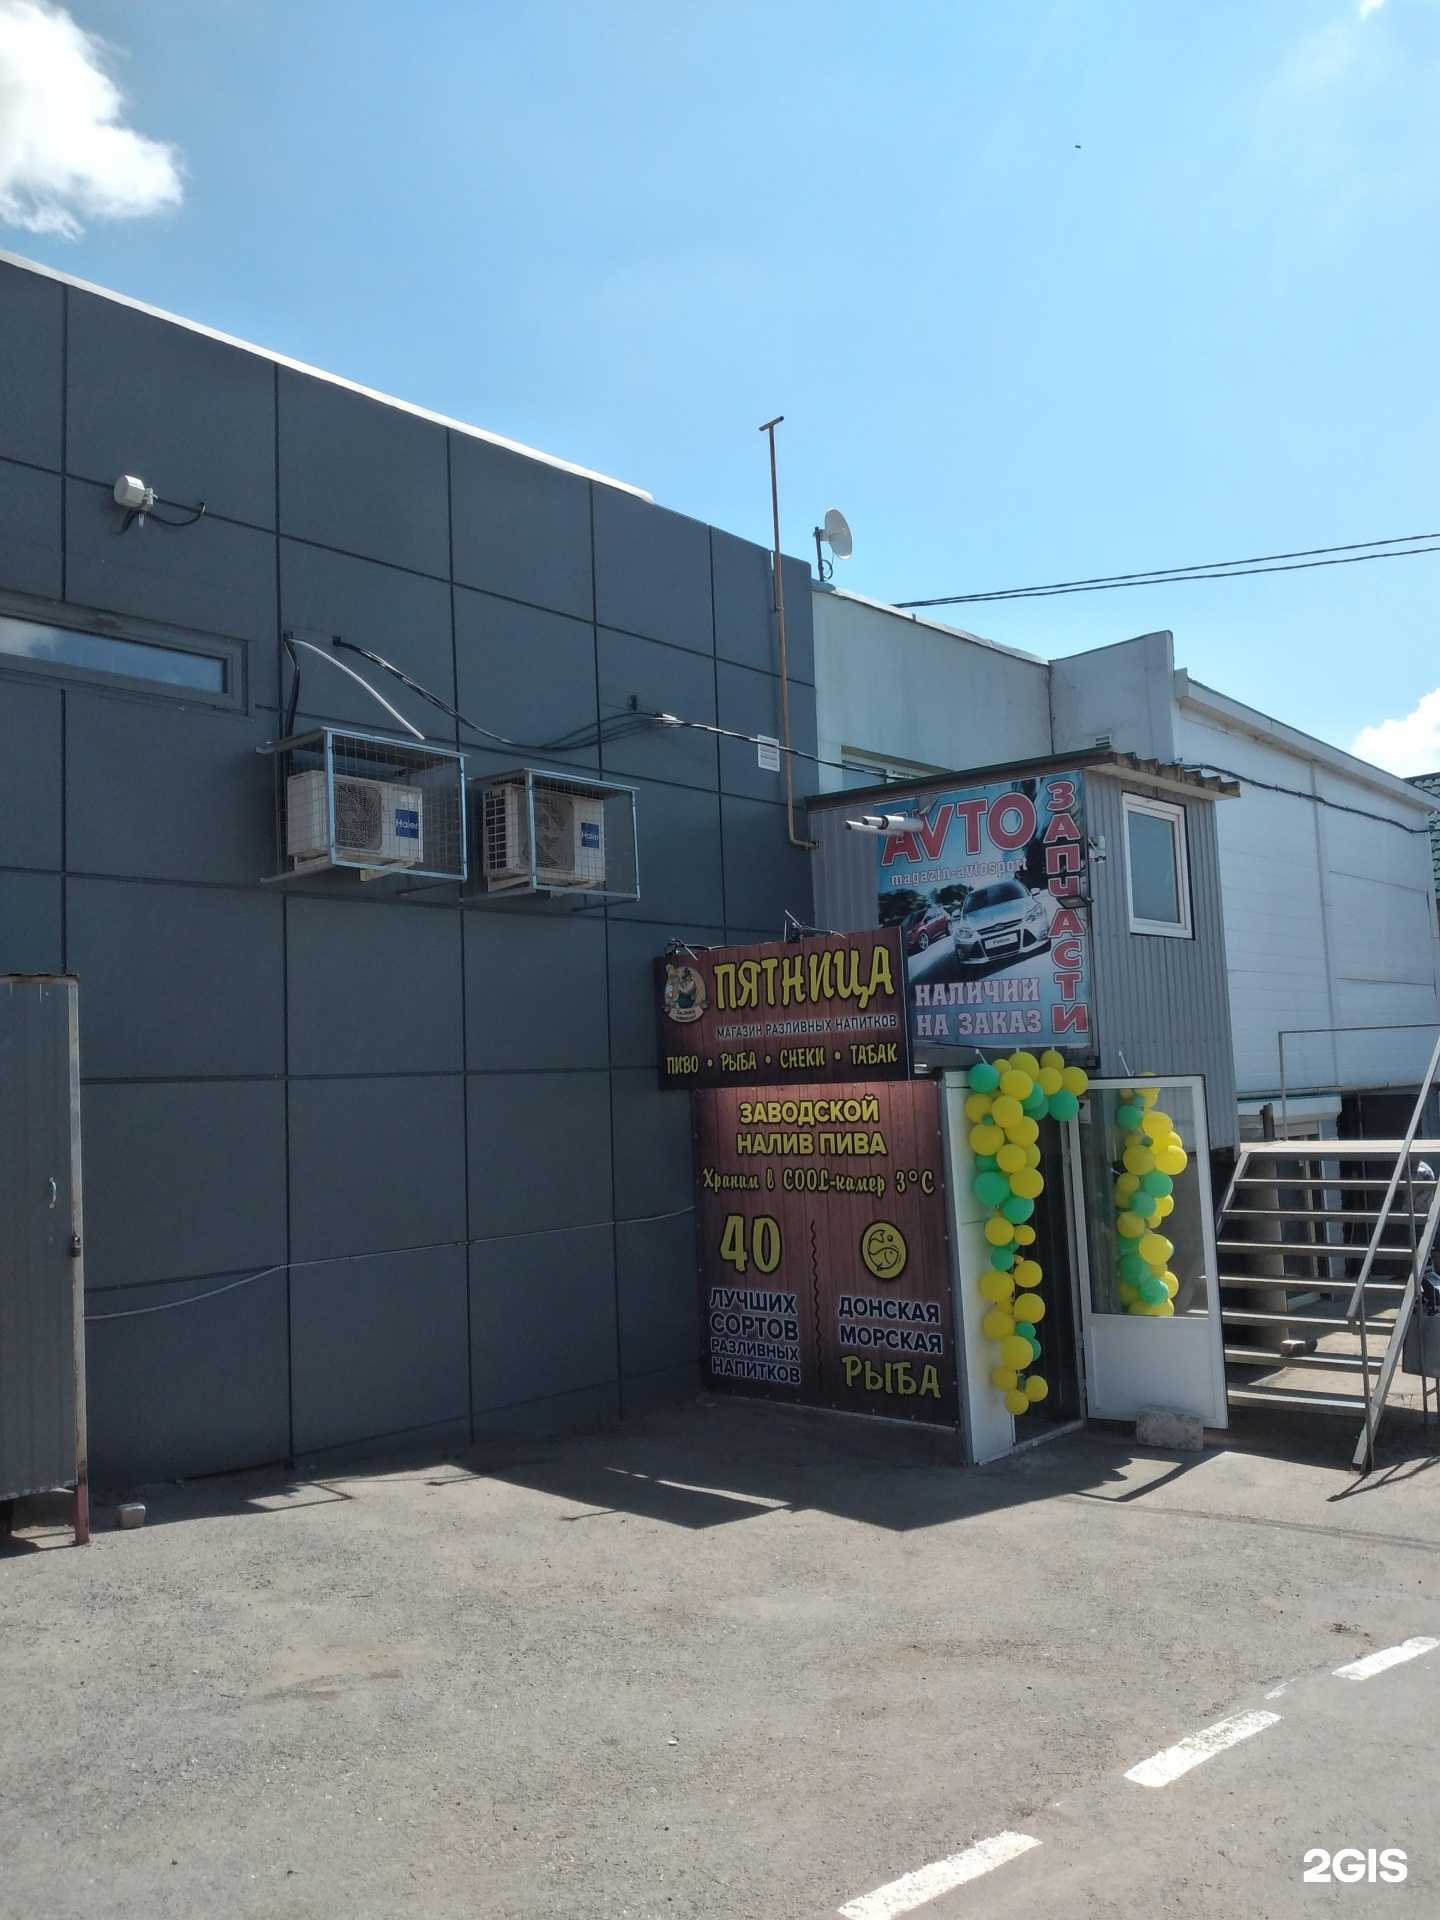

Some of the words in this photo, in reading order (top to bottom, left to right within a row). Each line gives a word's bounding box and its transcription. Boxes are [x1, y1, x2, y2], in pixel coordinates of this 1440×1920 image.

[714, 946, 895, 1010] ПЯТНИЦА
[915, 977, 1040, 1007] НАЛИЧИИ
[717, 1023, 764, 1041] МАГАЗИН
[765, 1017, 832, 1036] РАЗЛИВНЫХ
[835, 1013, 897, 1031] НАПИТКОВ
[916, 1014, 949, 1037] НА
[958, 1009, 1042, 1035] ЗАКАЗ
[666, 1055, 699, 1075] ПИВО
[720, 1052, 757, 1072] РЫБА
[779, 1047, 826, 1069] СНЕКИ
[850, 1043, 898, 1065] ТАБАК
[738, 1094, 881, 1127] ЗАВОДСКОЙ
[736, 1132, 815, 1155] НАЛИВ
[818, 1132, 888, 1155] ПИВА
[702, 1167, 760, 1193] Храним
[718, 1213, 783, 1274] 40
[710, 1288, 798, 1315] ЛУЧШИХ
[838, 1296, 941, 1324] ДОНСКАЯ
[711, 1312, 799, 1342] СОРТОВ
[839, 1324, 943, 1354] МОРСКАЯ
[711, 1337, 800, 1362] РАЗЛИВНЫХ
[712, 1357, 801, 1384] НАПИТКОВ
[841, 1354, 942, 1399] РЫБА
